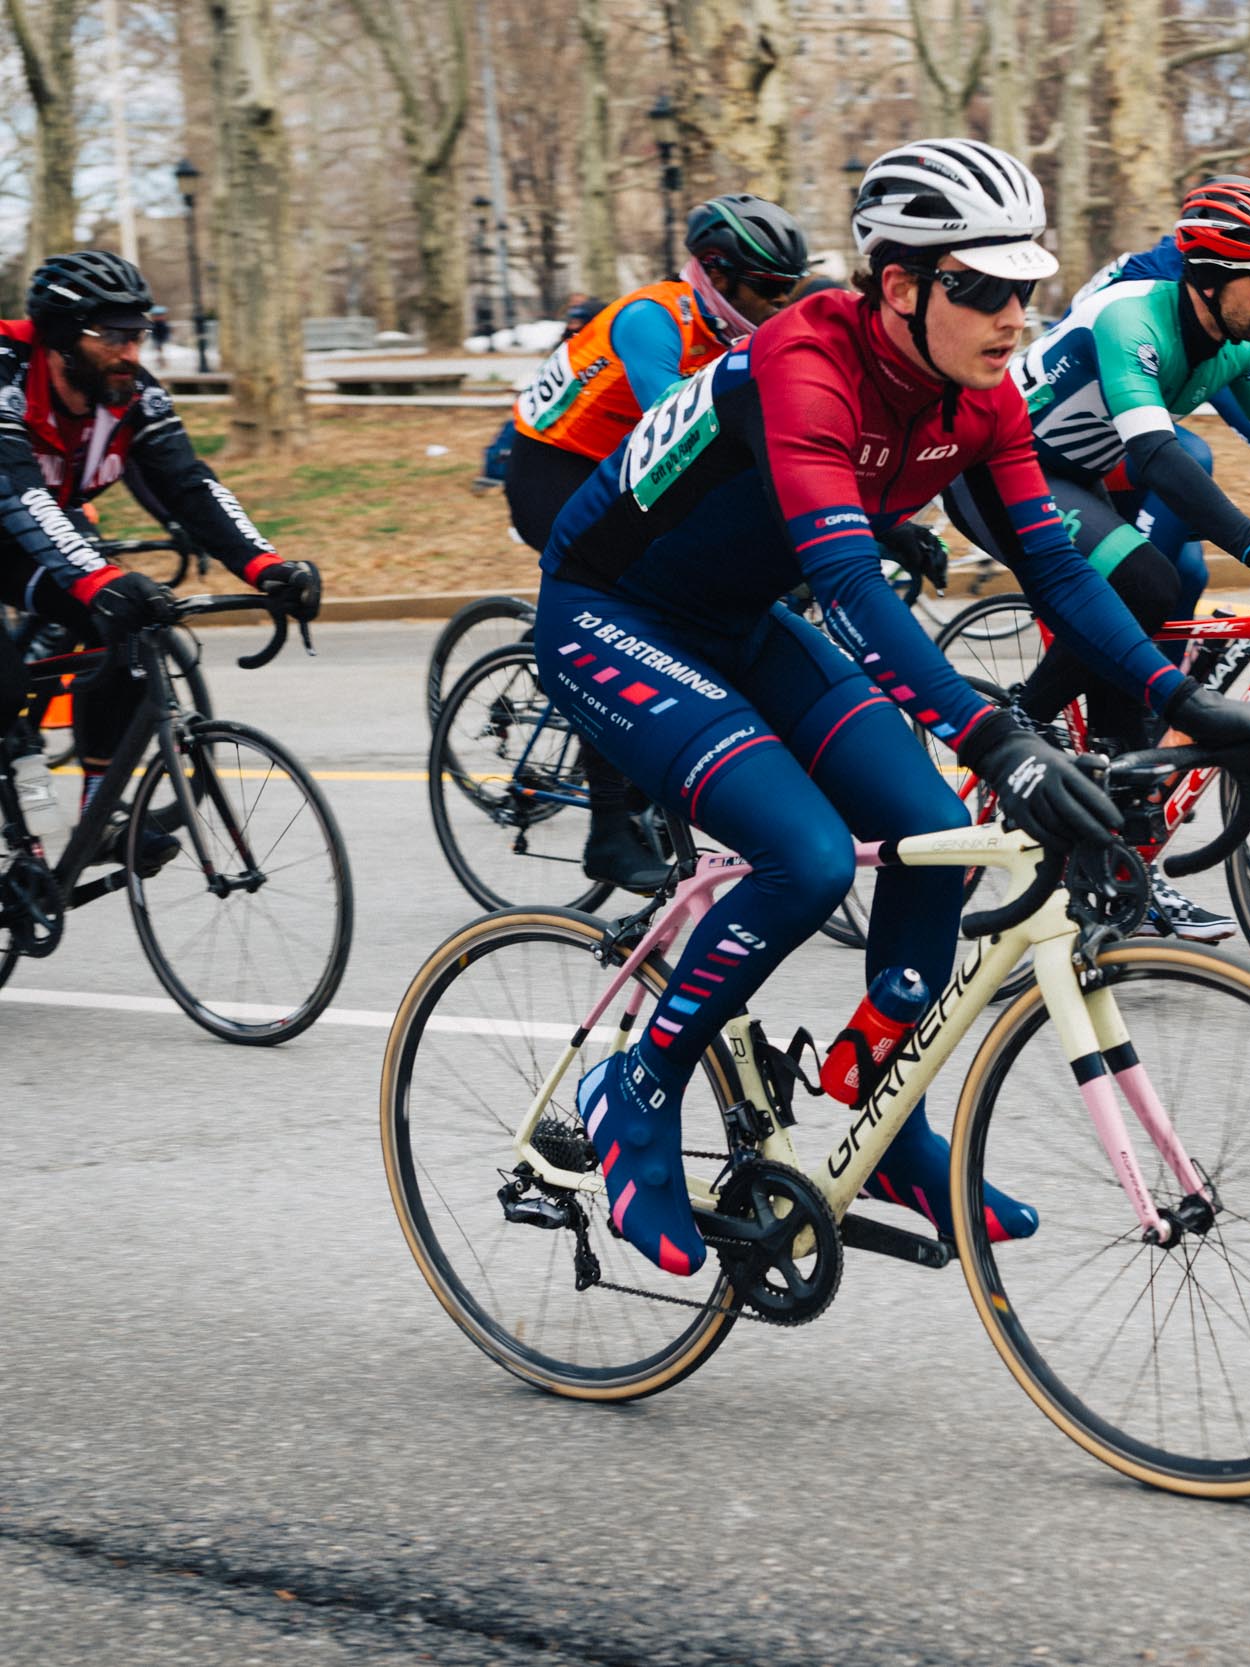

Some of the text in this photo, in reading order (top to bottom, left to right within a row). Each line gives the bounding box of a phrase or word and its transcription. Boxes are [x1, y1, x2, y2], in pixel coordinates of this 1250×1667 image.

[571, 610, 728, 701] TO BE DETERMINED
[557, 671, 579, 693] NEW
[581, 690, 607, 716] YORK
[610, 712, 635, 732] CITY
[684, 725, 757, 789] GARNEAU
[827, 936, 982, 1179] GARNEAU
